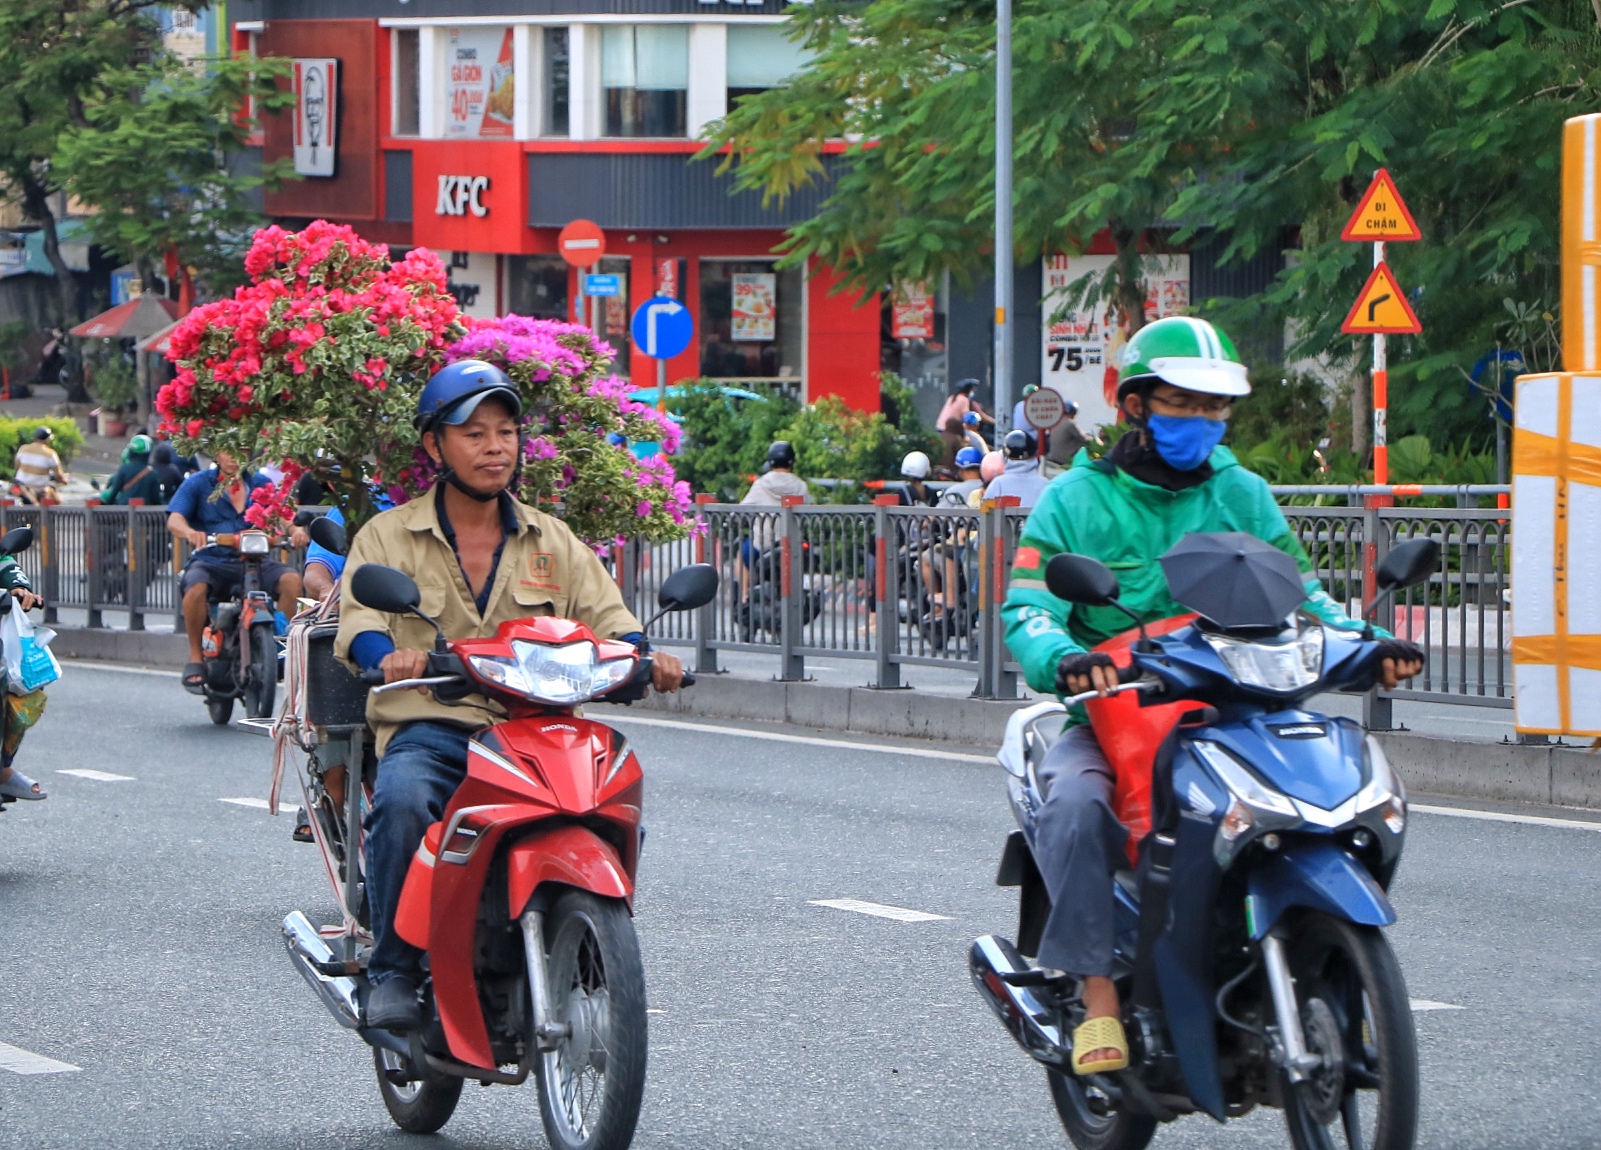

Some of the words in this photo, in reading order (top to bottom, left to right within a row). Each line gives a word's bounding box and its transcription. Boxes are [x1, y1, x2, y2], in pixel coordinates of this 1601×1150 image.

[435, 174, 489, 217] KFC
[1366, 217, 1397, 231] CHẬM
[1048, 347, 1083, 371] 75
[541, 724, 578, 732] HONDA
